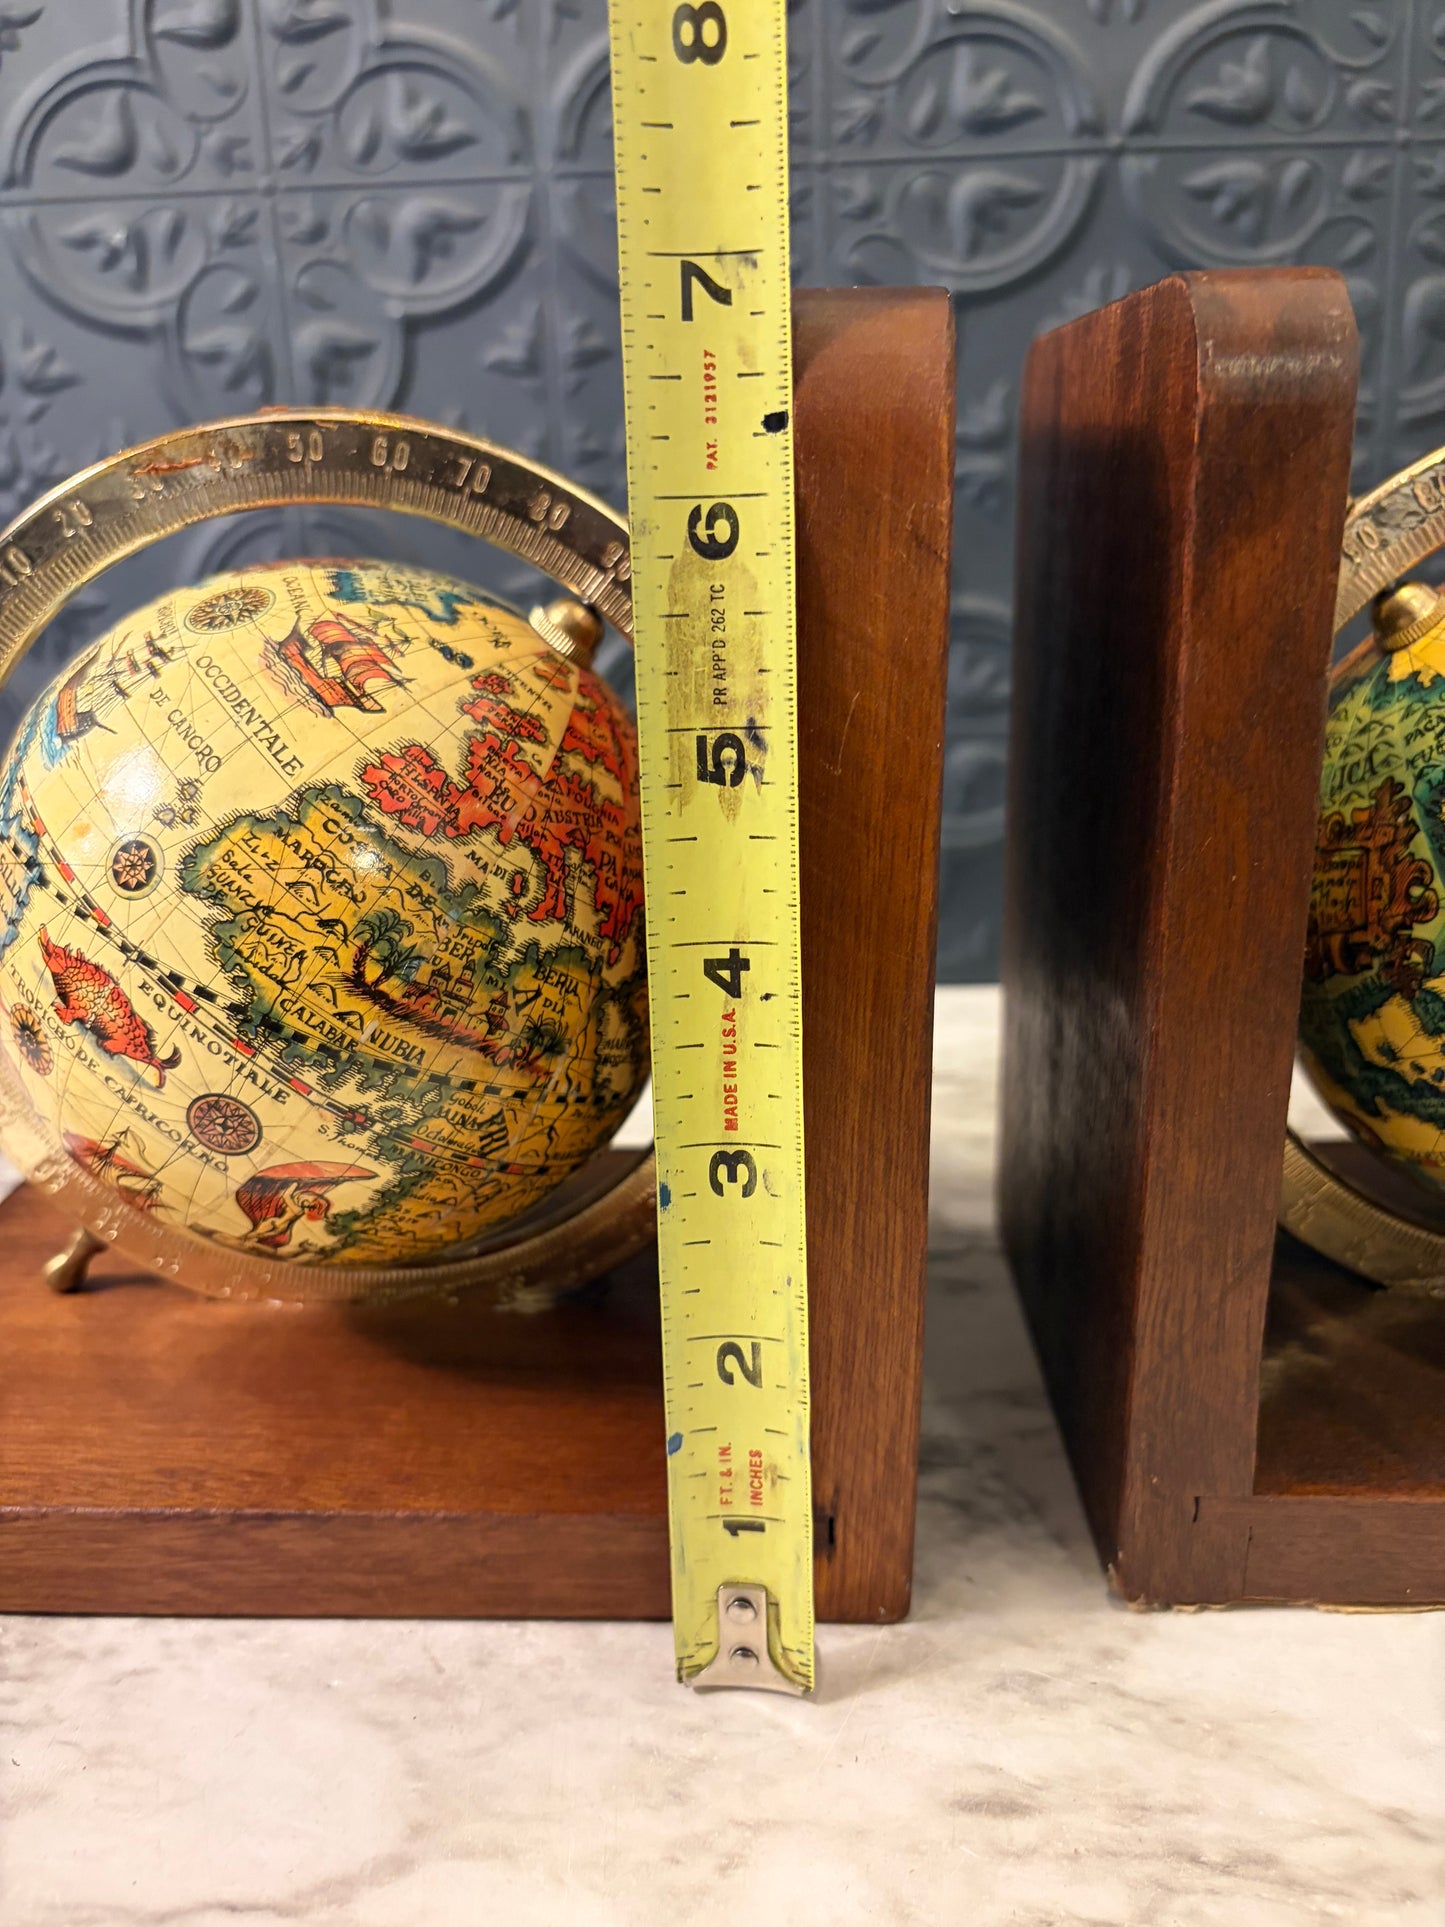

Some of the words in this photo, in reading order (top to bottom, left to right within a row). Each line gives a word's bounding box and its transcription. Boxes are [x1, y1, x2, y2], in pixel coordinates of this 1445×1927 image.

[672, 1, 727, 65] 8
[680, 260, 733, 322] 7
[369, 436, 411, 471] 60
[456, 457, 492, 493] 70
[530, 494, 571, 531] 80
[687, 502, 740, 561] 6
[710, 583, 725, 602] TC
[711, 608, 726, 633] 262
[712, 639, 727, 681] APP'D
[150, 687, 171, 707] DE
[195, 655, 305, 777] OCCIDENTALE
[713, 687, 728, 705] PR
[696, 732, 746, 789] 5
[322, 818, 393, 880] COSA
[405, 882, 439, 911] DE
[240, 917, 309, 961] GUINEA
[703, 948, 750, 999] 4
[137, 978, 288, 1106] EQUINOTIALE
[278, 997, 362, 1053] CALABAR
[369, 1027, 428, 1067] NUBIA
[722, 1061, 737, 1079] IN
[75, 1045, 101, 1072] DE
[104, 1073, 231, 1174] CAPRICORNO
[723, 1084, 739, 1132] MADE
[390, 1143, 483, 1179] MANICONGO
[708, 1149, 758, 1199] 3
[716, 1341, 763, 1389] 2
[718, 1442, 732, 1463] IN.
[719, 1482, 733, 1506] FT.
[748, 1449, 763, 1507] INCHES
[722, 1519, 766, 1537] 1
